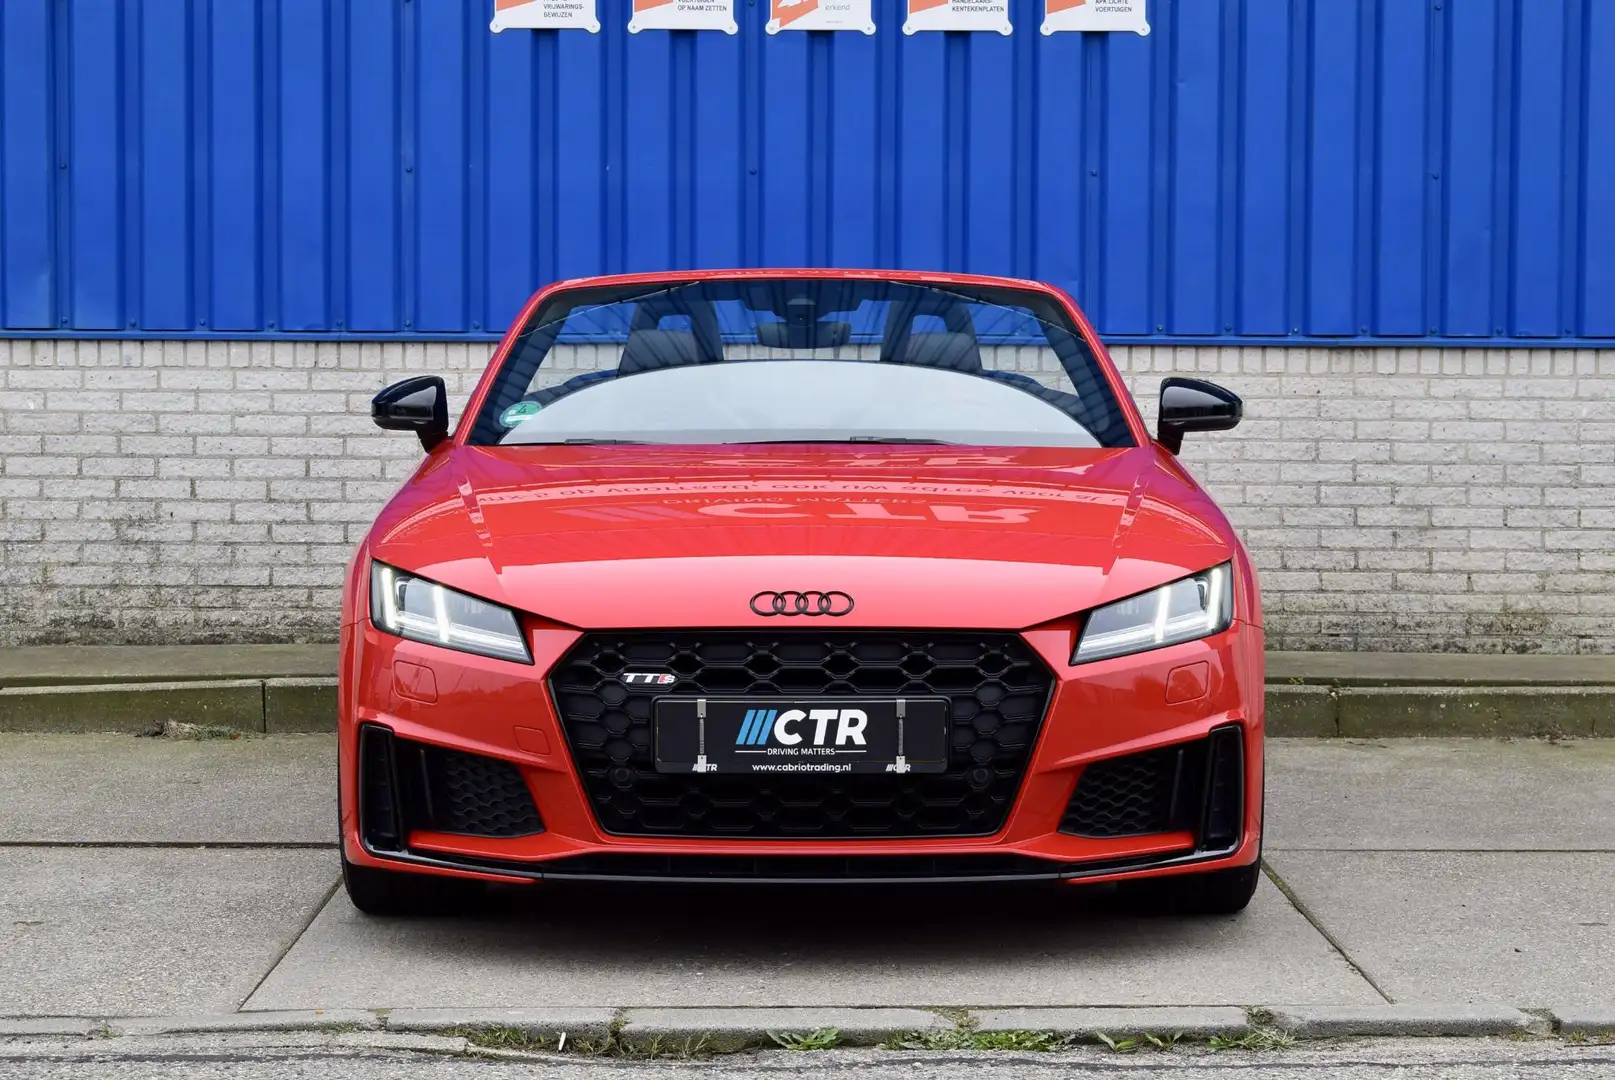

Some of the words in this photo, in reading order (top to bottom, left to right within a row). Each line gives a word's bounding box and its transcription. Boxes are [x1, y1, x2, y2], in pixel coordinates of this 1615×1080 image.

[518, 404, 527, 414] 4
[623, 673, 676, 684] TTS
[773, 709, 868, 745] CTR
[767, 748, 799, 756] DRIVING
[800, 748, 836, 756] MATTERS
[751, 763, 852, 773] www.cabriotrading.nl
